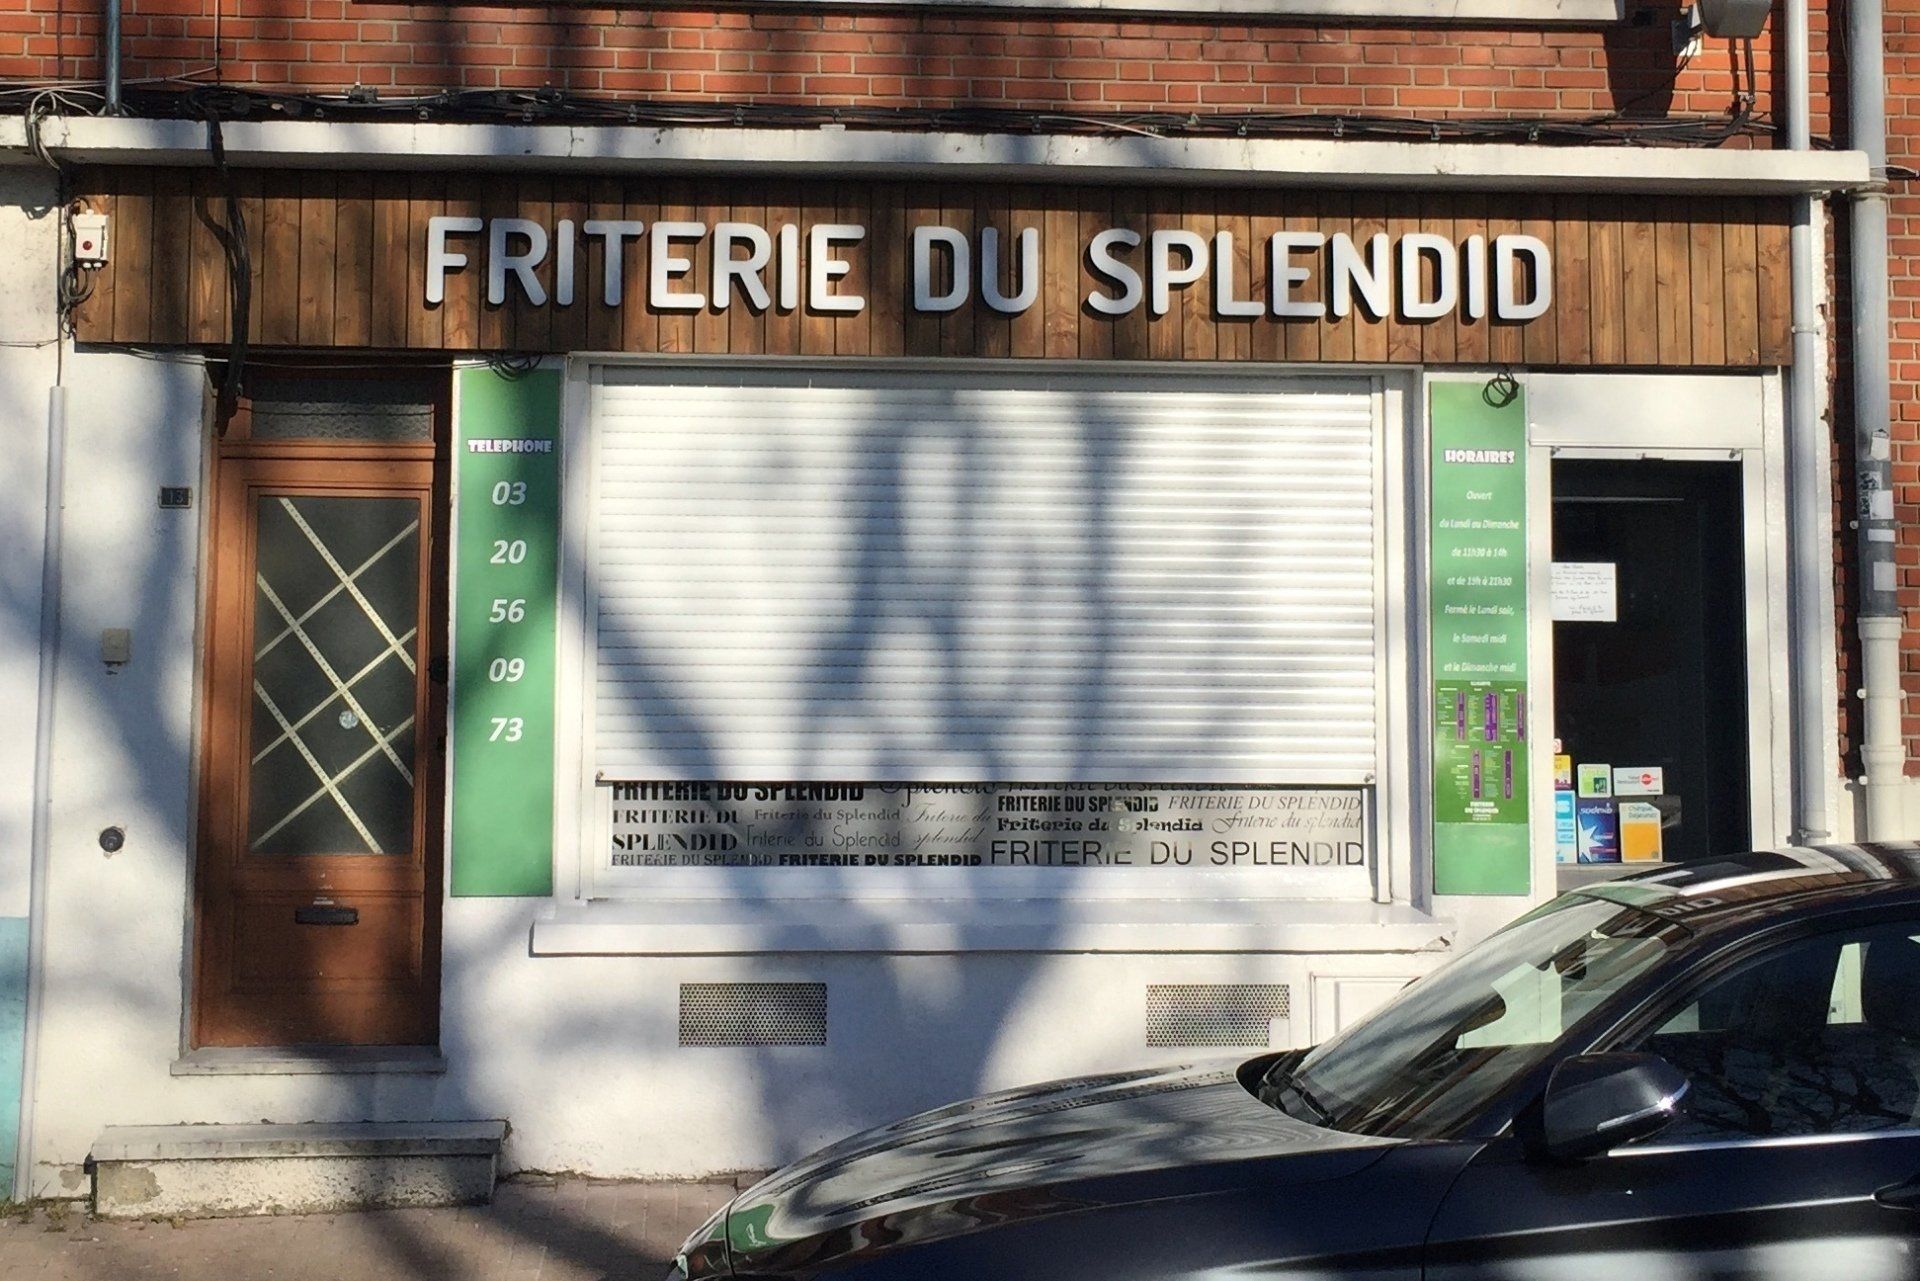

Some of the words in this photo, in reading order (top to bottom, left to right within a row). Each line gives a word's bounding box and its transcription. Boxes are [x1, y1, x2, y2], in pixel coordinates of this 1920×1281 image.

[426, 216, 866, 311] FRITERIE
[914, 225, 1039, 313] DU
[1088, 227, 1552, 320] SPLENDID
[468, 439, 553, 453] TELEPHONE
[1444, 449, 1516, 464] HORAIRES
[492, 481, 527, 505] 03
[1466, 490, 1493, 500] Ouvert
[1450, 519, 1471, 529] Lundi
[1482, 519, 1520, 530] Dimanche
[490, 540, 527, 564] 20
[489, 598, 527, 623] 56
[1477, 605, 1498, 615] Lundi
[1461, 633, 1489, 644] Samedi
[1490, 634, 1507, 643] midi
[488, 657, 526, 682] 09
[1461, 662, 1499, 672] Dimanche
[1499, 663, 1517, 672] midi
[488, 717, 524, 742] 73
[612, 782, 711, 801] FRITERIE
[717, 782, 748, 801] DU
[754, 782, 864, 801] SPLENDID
[998, 795, 1061, 812] FRITERIE
[1065, 795, 1085, 812] DU
[1168, 796, 1244, 810] FRITERIE
[1248, 796, 1275, 810] DU
[1277, 796, 1361, 811] SPLENDID
[613, 809, 712, 824] FRITERIE
[755, 808, 809, 821] Friterie
[813, 808, 832, 820] du
[997, 817, 1083, 832] Friterie
[612, 833, 738, 851] SPLENDID
[804, 831, 824, 847] du
[832, 824, 901, 852] Splendid
[612, 854, 677, 867] FRITERIE
[682, 854, 701, 867] DU
[779, 853, 859, 867] FRITERIE
[865, 853, 888, 867] DU
[894, 853, 982, 867] SPLENDID
[991, 840, 1132, 865] FRITERIE
[1150, 841, 1192, 866] DU
[1210, 841, 1364, 866] SPLENDID
